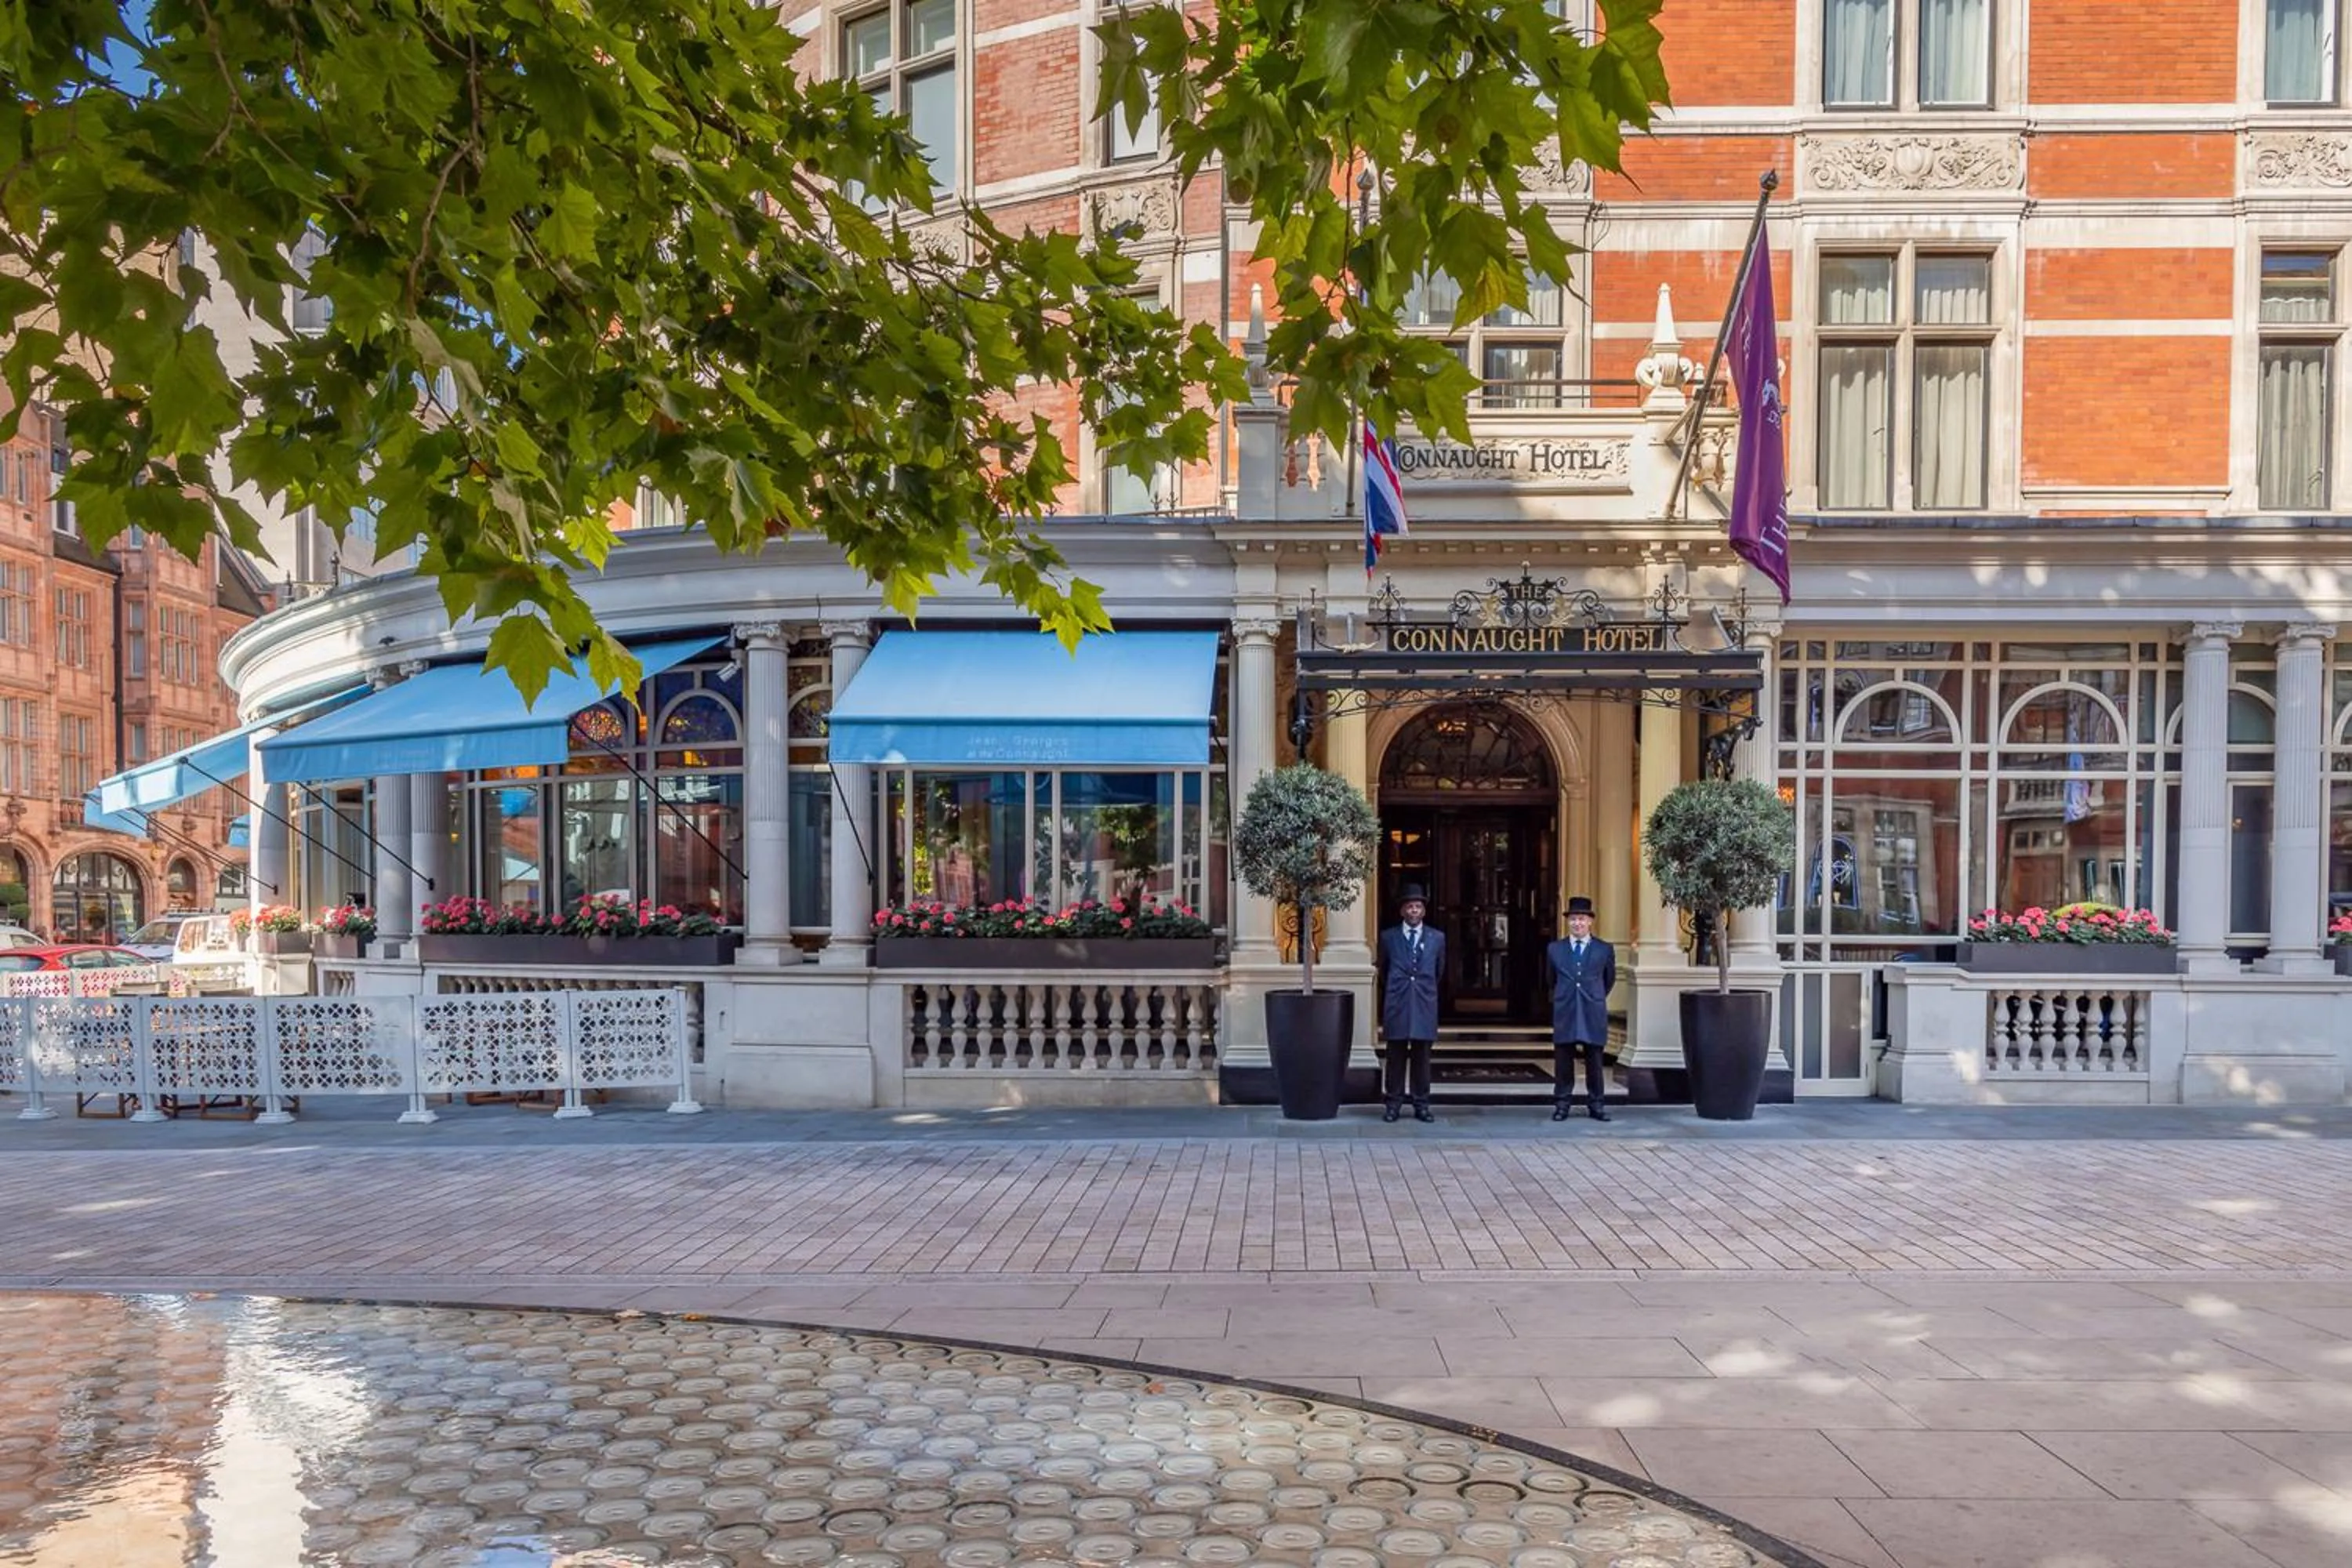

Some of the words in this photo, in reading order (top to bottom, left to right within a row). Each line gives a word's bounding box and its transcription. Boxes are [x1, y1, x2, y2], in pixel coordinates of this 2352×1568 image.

[1399, 445, 1518, 472] CONNAUGHT
[1528, 444, 1610, 472] HOTEL
[1509, 585, 1544, 600] THE
[1392, 628, 1566, 652] CONNAUGHT
[1583, 628, 1665, 652] HOTEL
